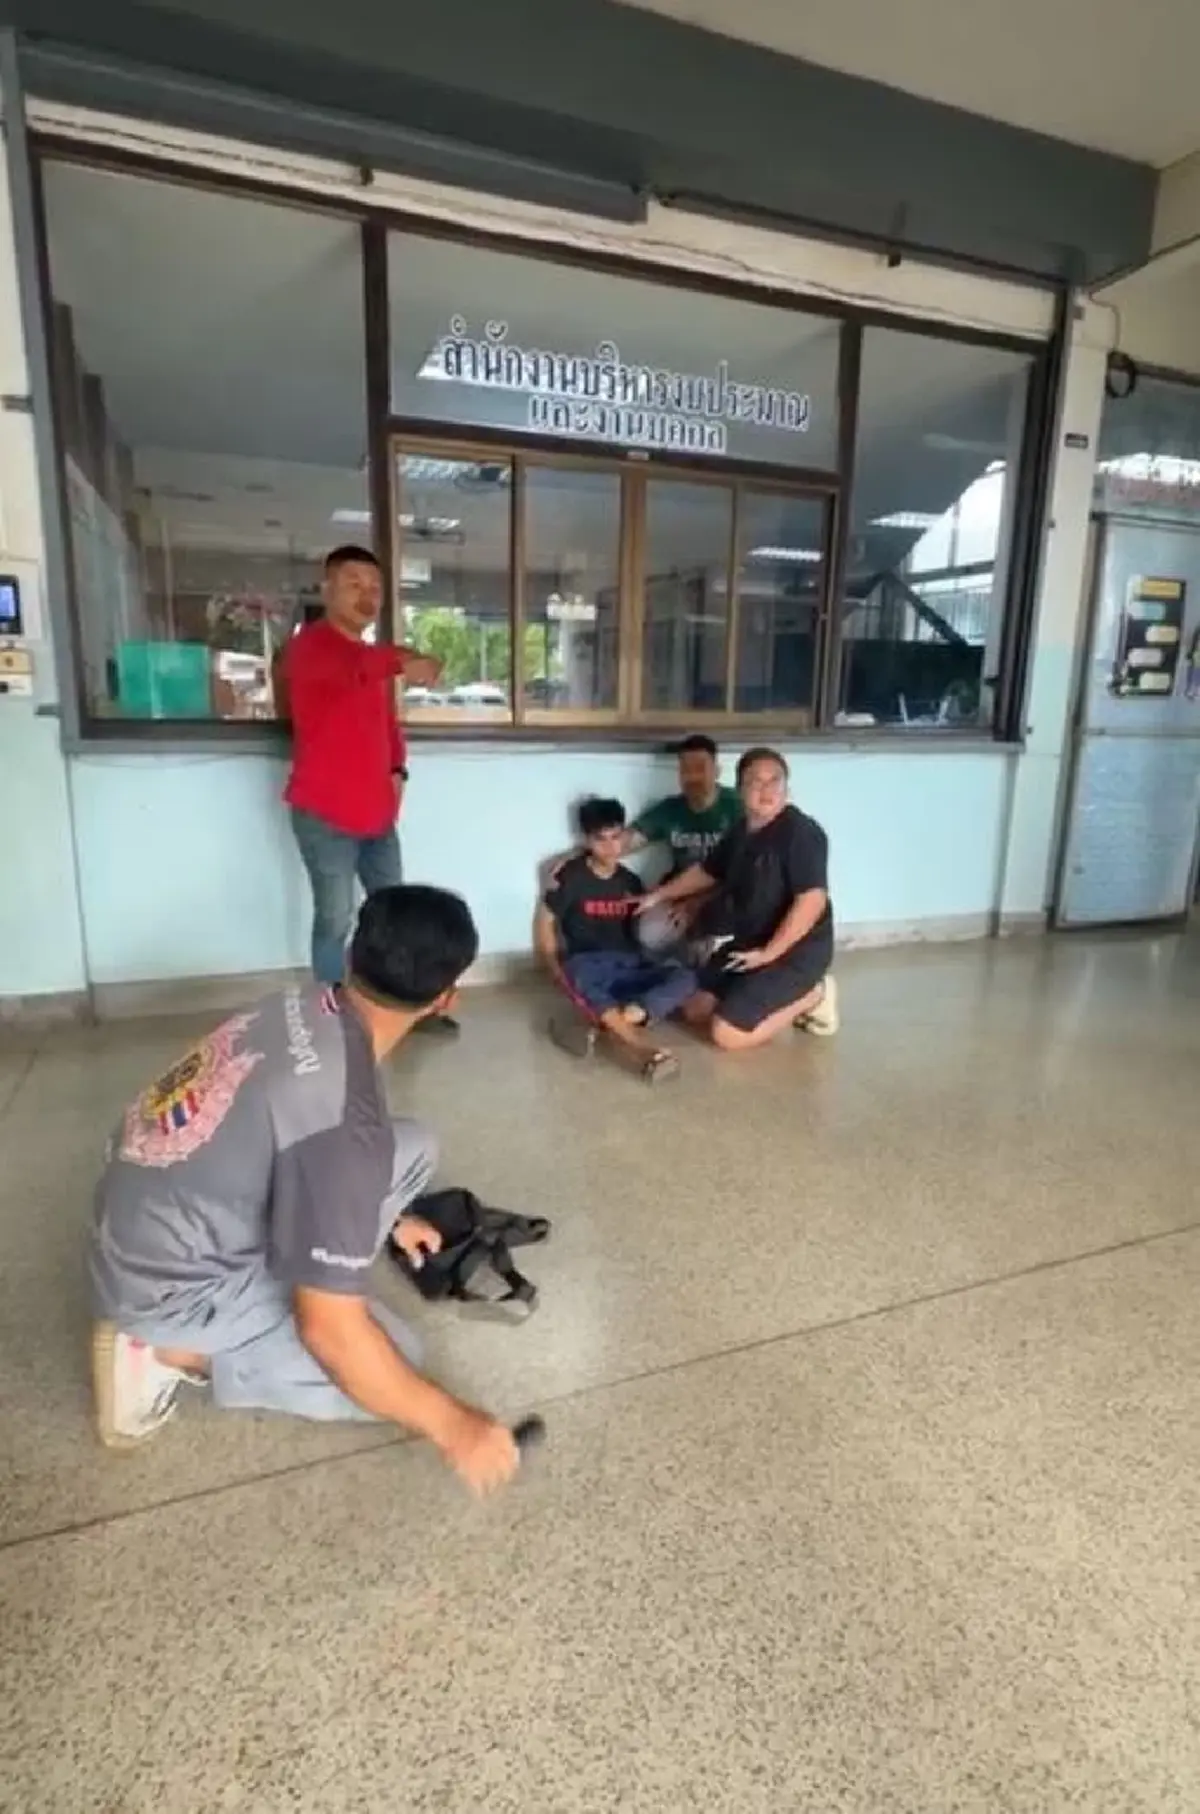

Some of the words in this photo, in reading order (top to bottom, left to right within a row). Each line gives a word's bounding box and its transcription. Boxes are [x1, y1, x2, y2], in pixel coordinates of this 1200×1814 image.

[442, 314, 809, 432] สำนักงานบริหารงบประมาณ
[530, 395, 726, 451] และงานบคคล
